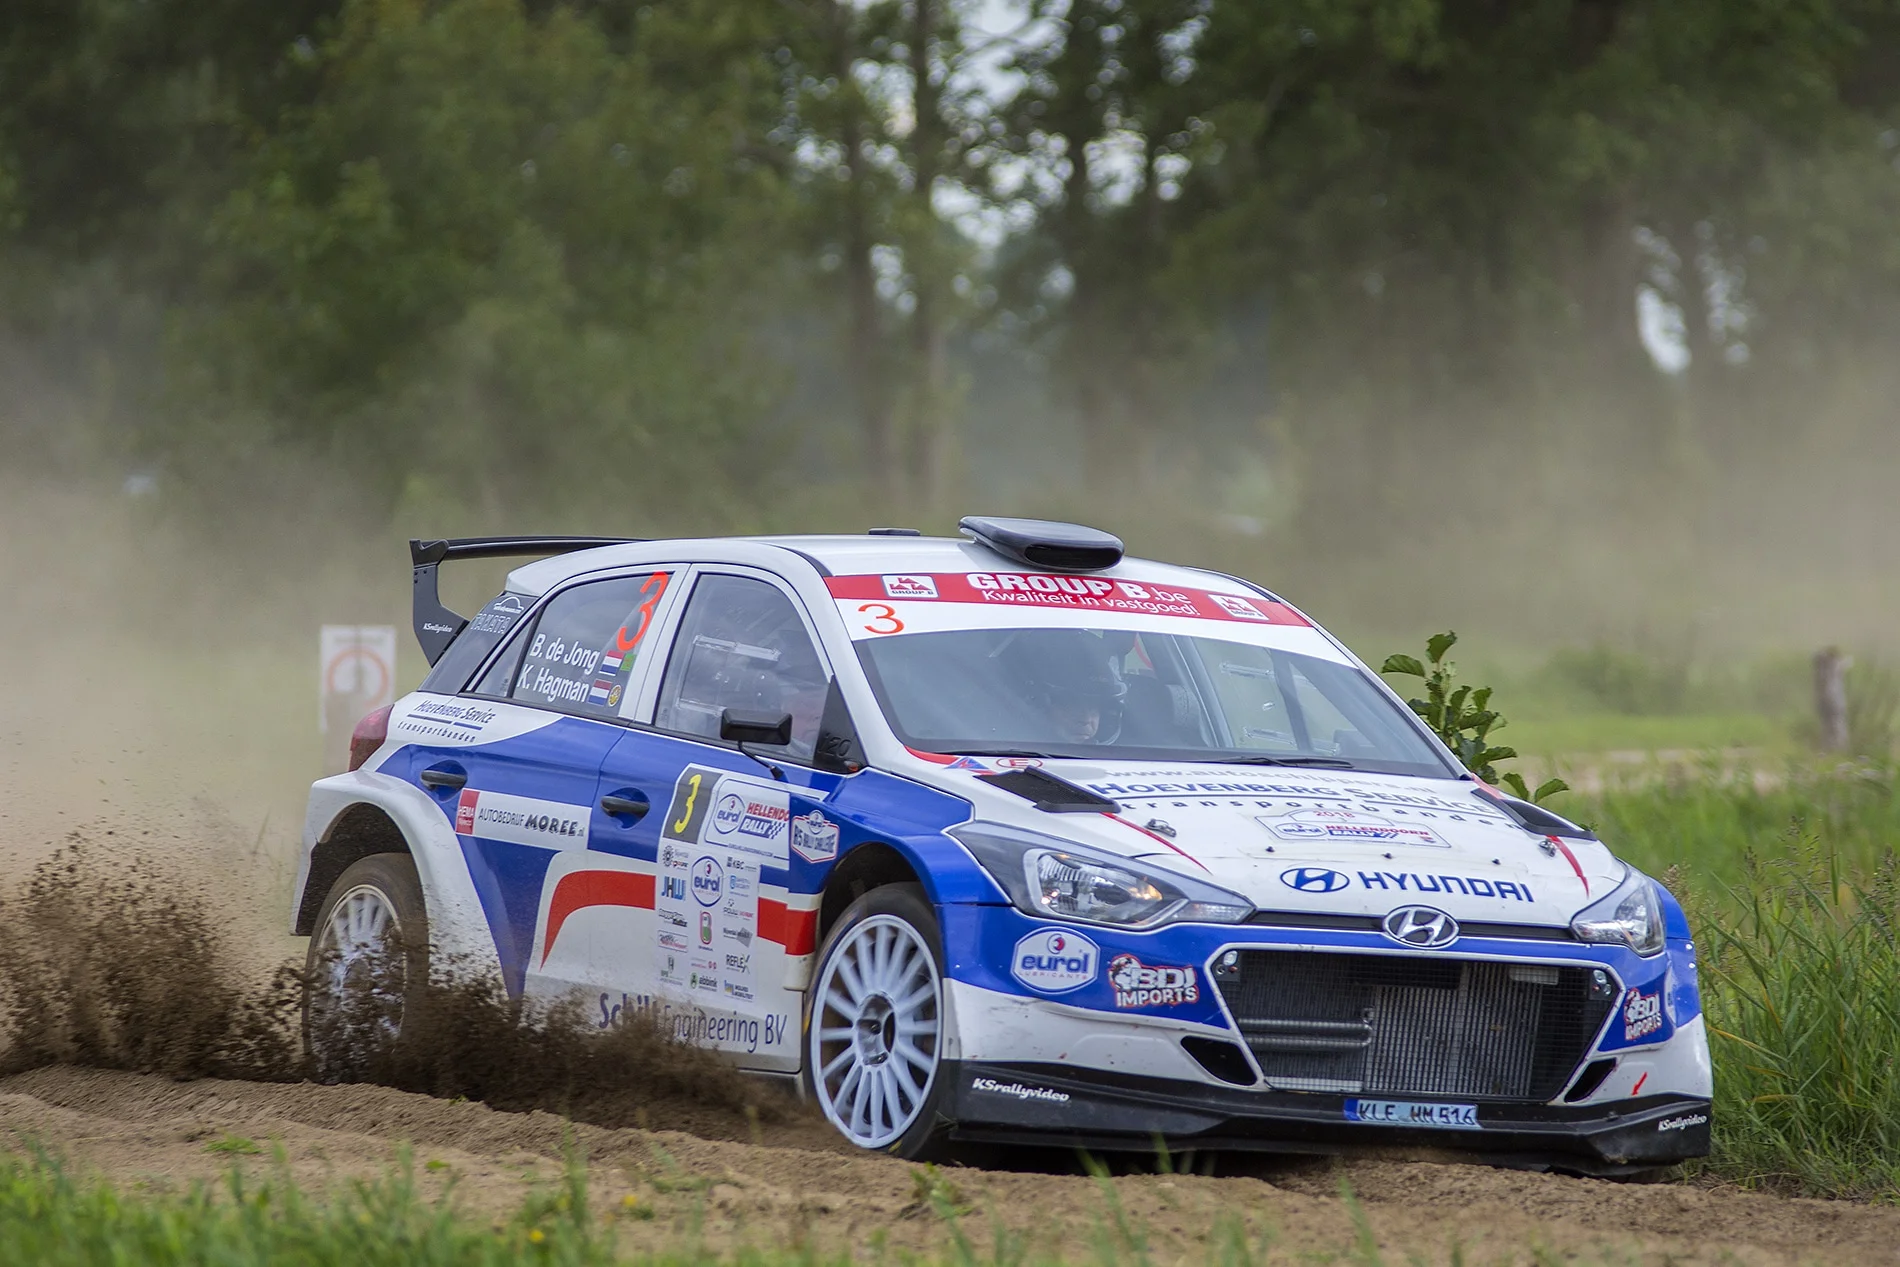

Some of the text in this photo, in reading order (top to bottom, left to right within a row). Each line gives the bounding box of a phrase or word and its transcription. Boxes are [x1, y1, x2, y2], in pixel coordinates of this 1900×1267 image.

[966, 573, 1113, 596] GROUP
[616, 571, 668, 651] 3
[982, 590, 1201, 616] Kwaliteit in vastgoed!
[857, 603, 905, 635] 3
[529, 633, 600, 675] B. de Jong
[516, 663, 590, 703] K. Hagman
[413, 699, 496, 724] HOEVENBERG SERVICE
[397, 721, 476, 743] transportbanden
[1087, 783, 1342, 797] HOEVENBERG
[674, 774, 702, 833] 3
[716, 809, 742, 824] eurol
[741, 818, 771, 835] RALLY
[1325, 825, 1430, 837] HELLENDOORN
[694, 875, 721, 892] eurol
[1357, 871, 1535, 903] HYUNDAI
[1021, 953, 1090, 974] eurol
[1116, 986, 1198, 1008] IMPORTS
[764, 1013, 788, 1046] BV
[972, 1077, 1071, 1101] KSrallyvideo
[1359, 1103, 1398, 1122] KLE
[1439, 1106, 1475, 1126] 516
[1658, 1114, 1708, 1131] KSrallyvideo
